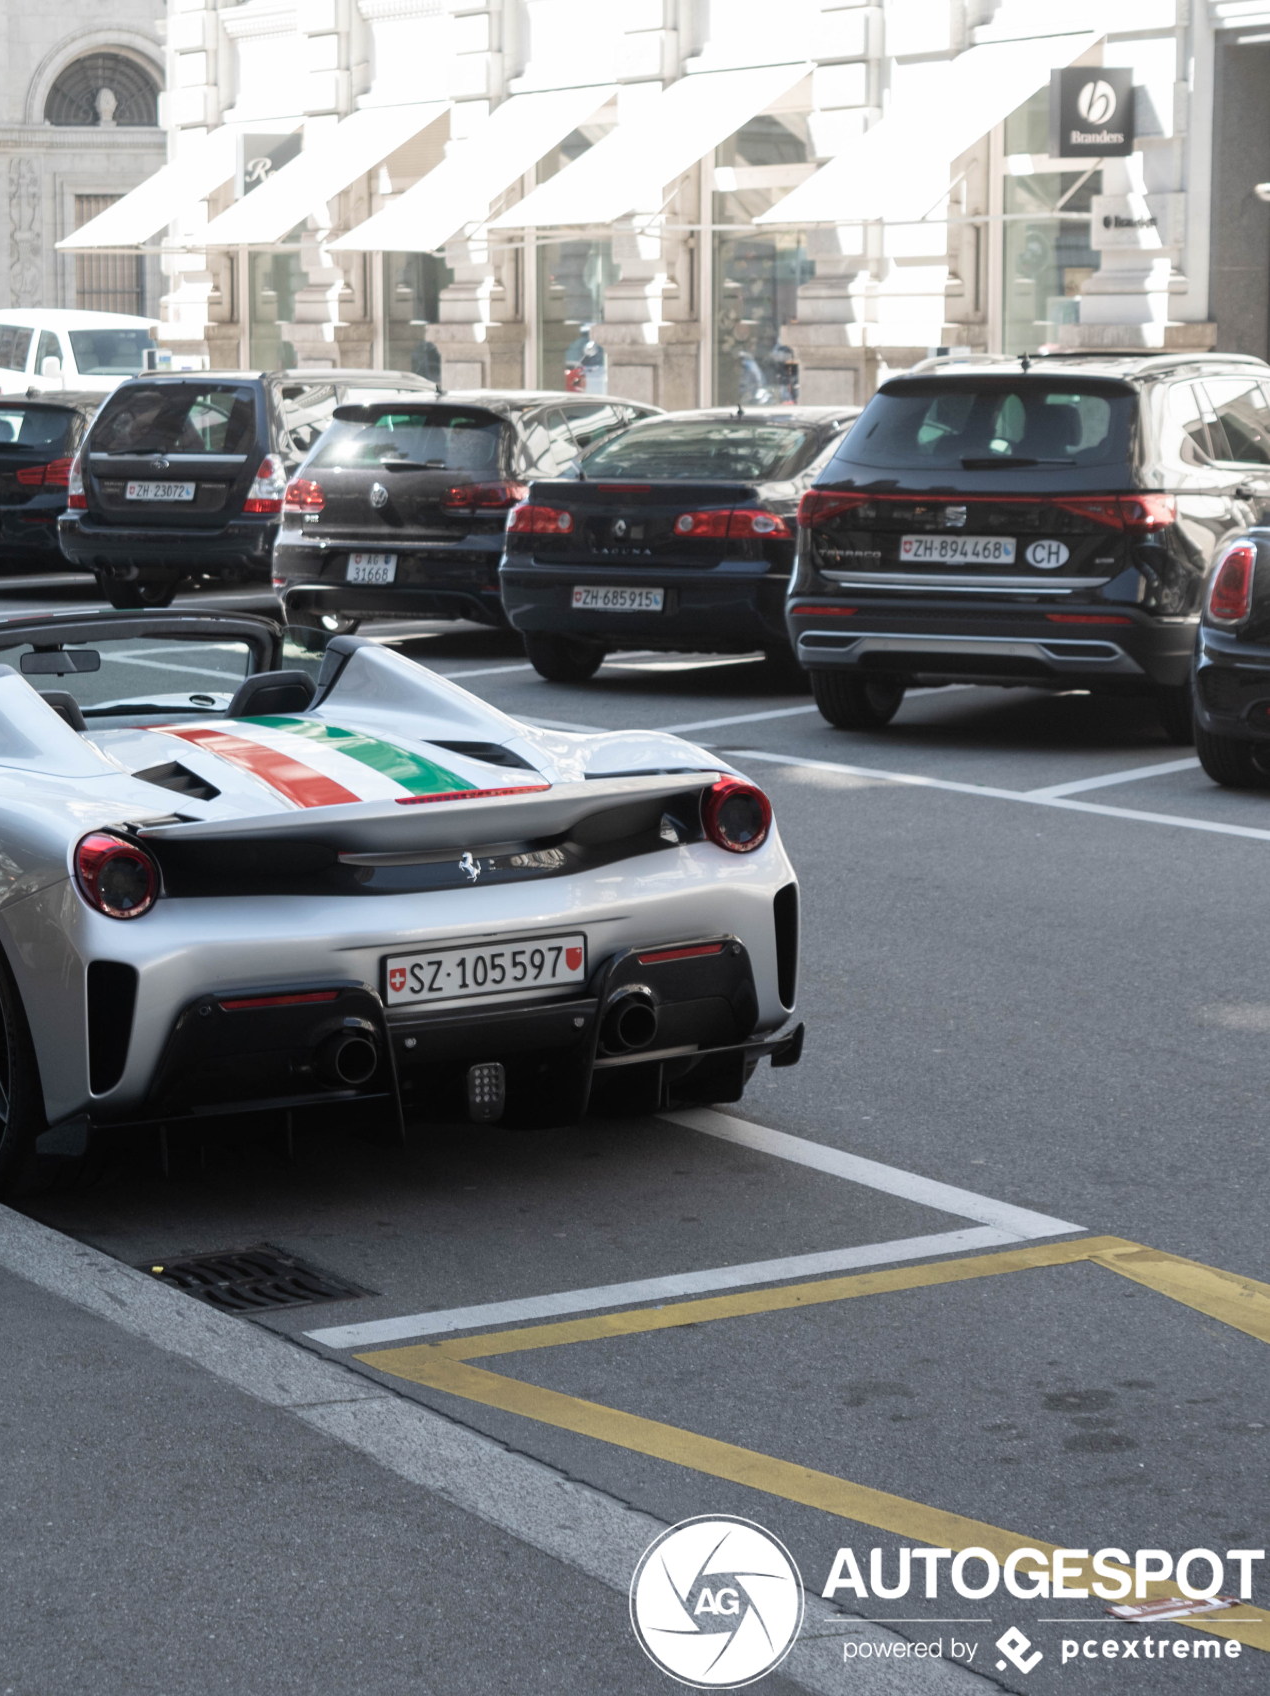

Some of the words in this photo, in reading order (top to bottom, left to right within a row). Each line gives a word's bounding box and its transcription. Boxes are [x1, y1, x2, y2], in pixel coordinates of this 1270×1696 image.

[1070, 129, 1125, 144] Branders
[245, 157, 277, 182] R
[1032, 543, 1061, 564] CH
[353, 567, 389, 581] 31668
